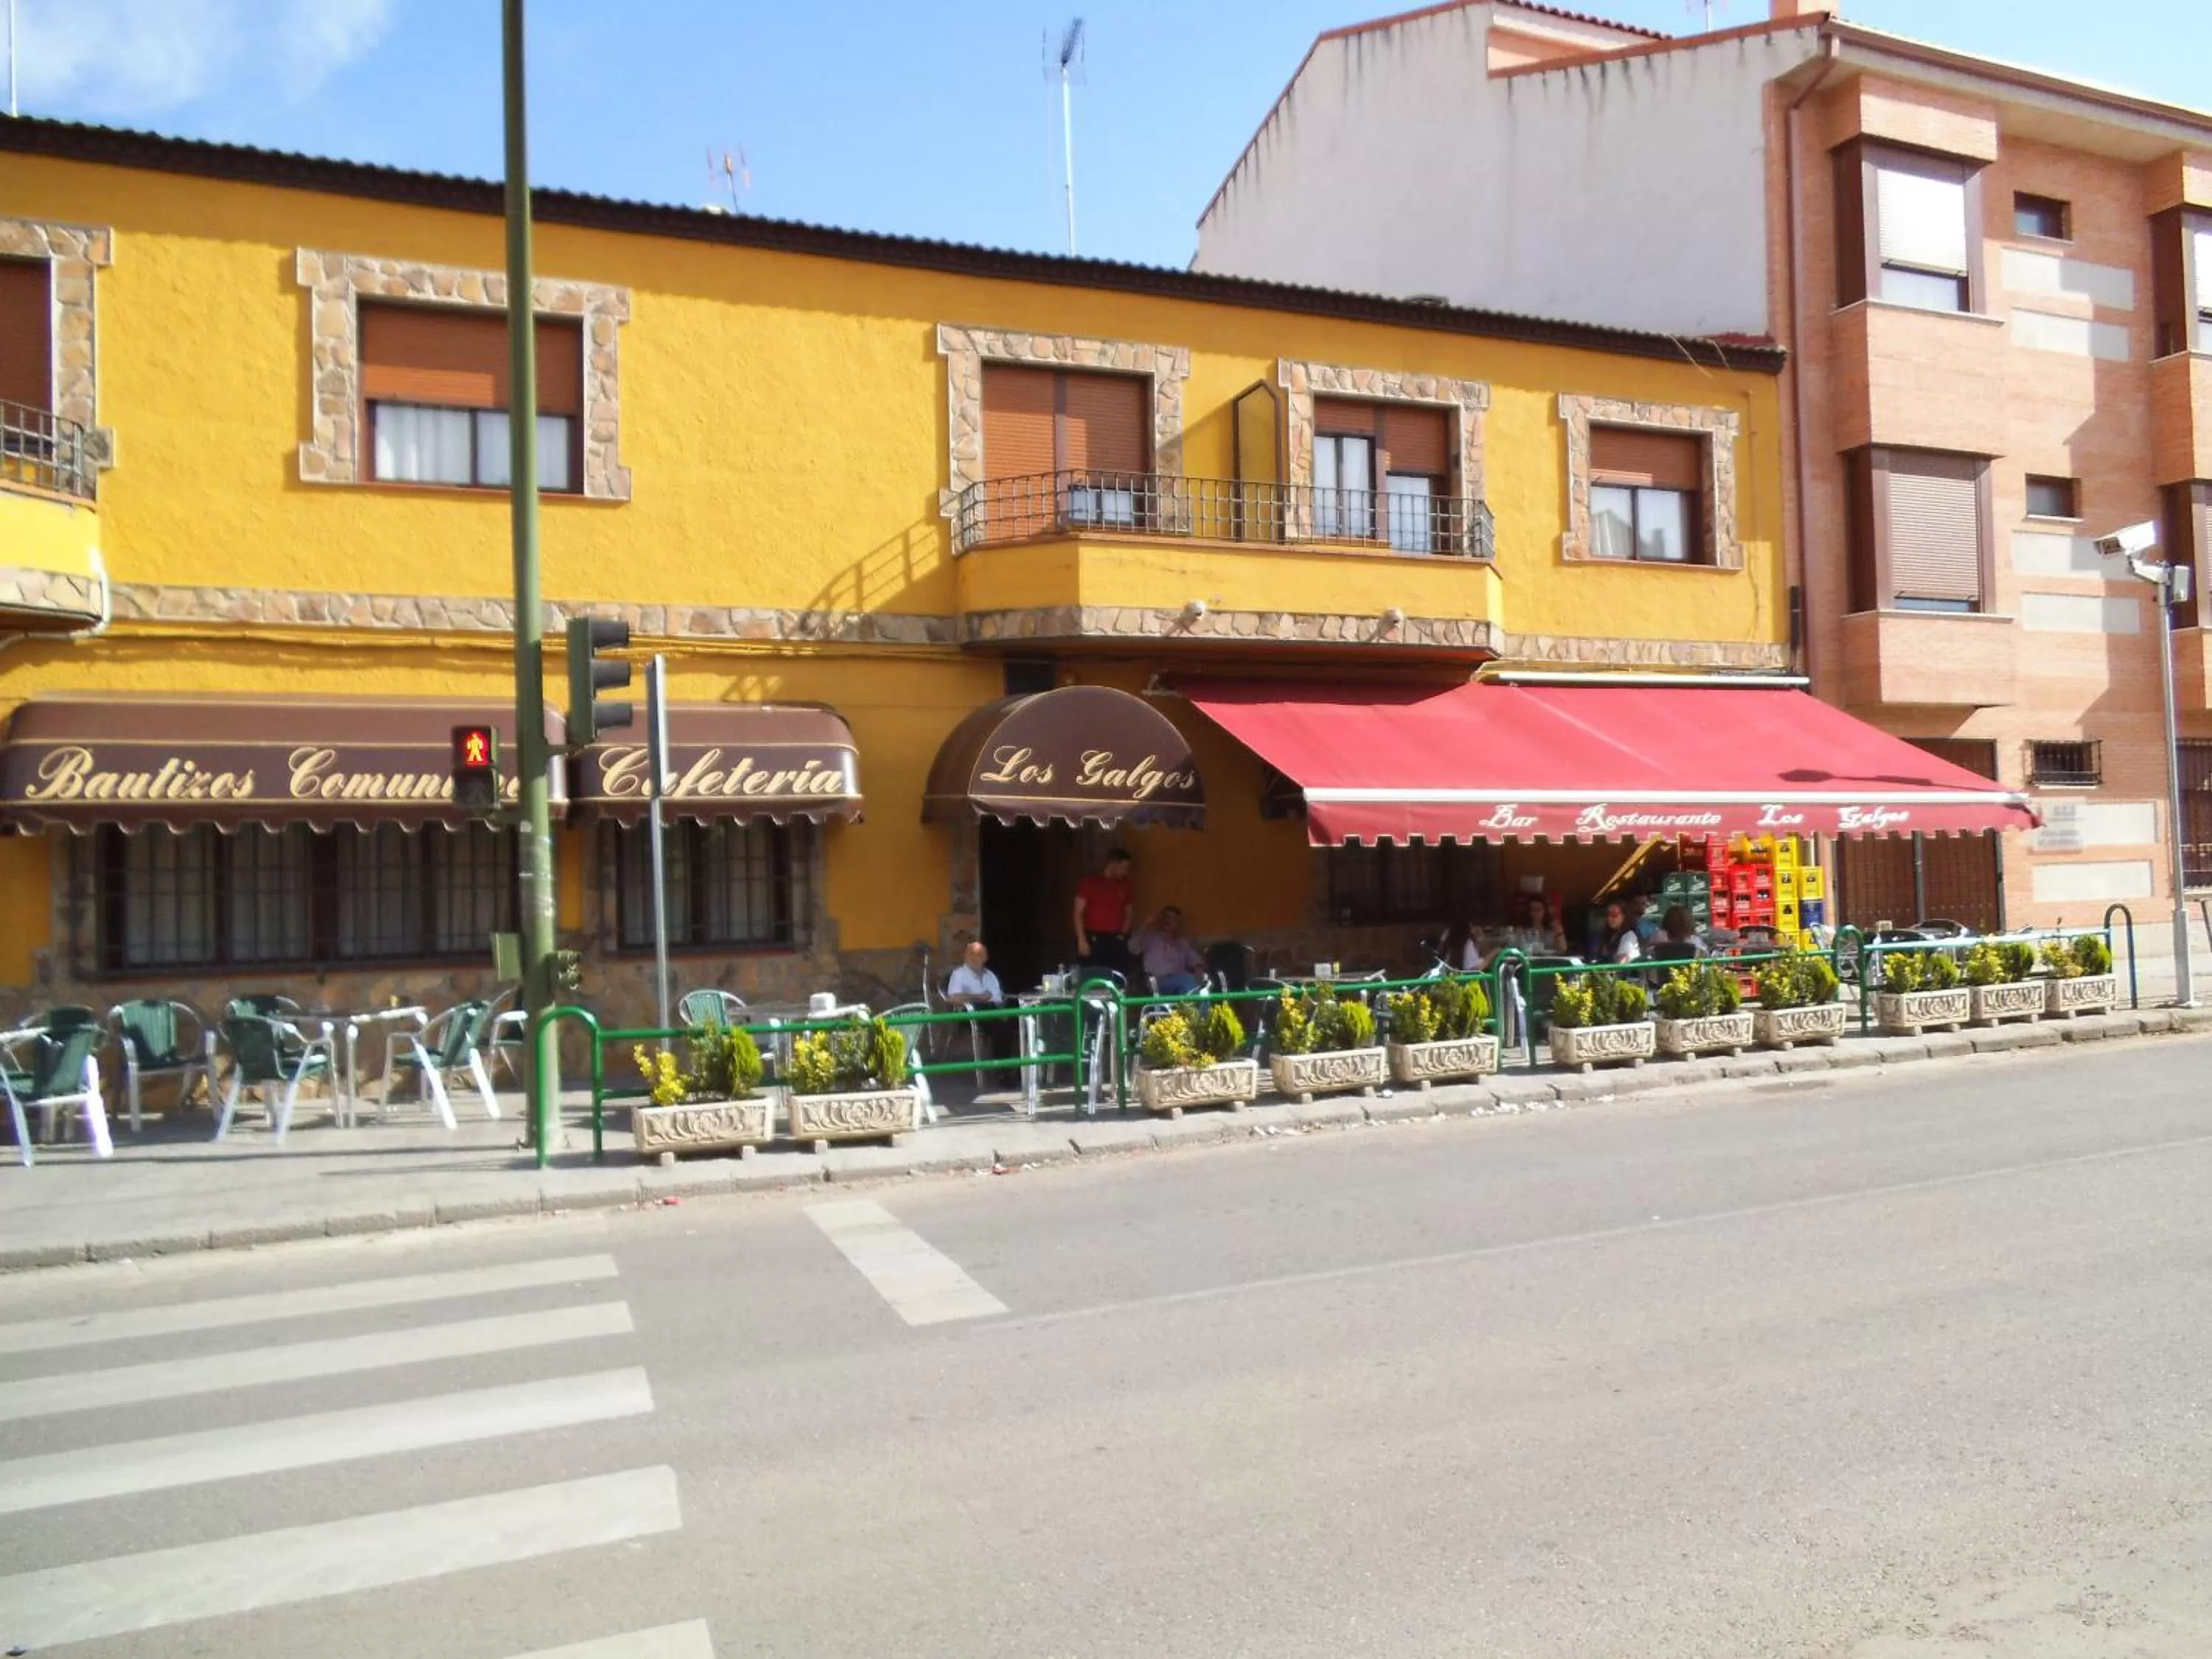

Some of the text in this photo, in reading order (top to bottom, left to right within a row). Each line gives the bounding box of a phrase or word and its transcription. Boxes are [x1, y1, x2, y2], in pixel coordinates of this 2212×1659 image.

[26, 745, 255, 799] Bautizos
[980, 745, 1196, 799] Los Galgos
[1478, 803, 1910, 832] Bar Restaurante Los Galgos
